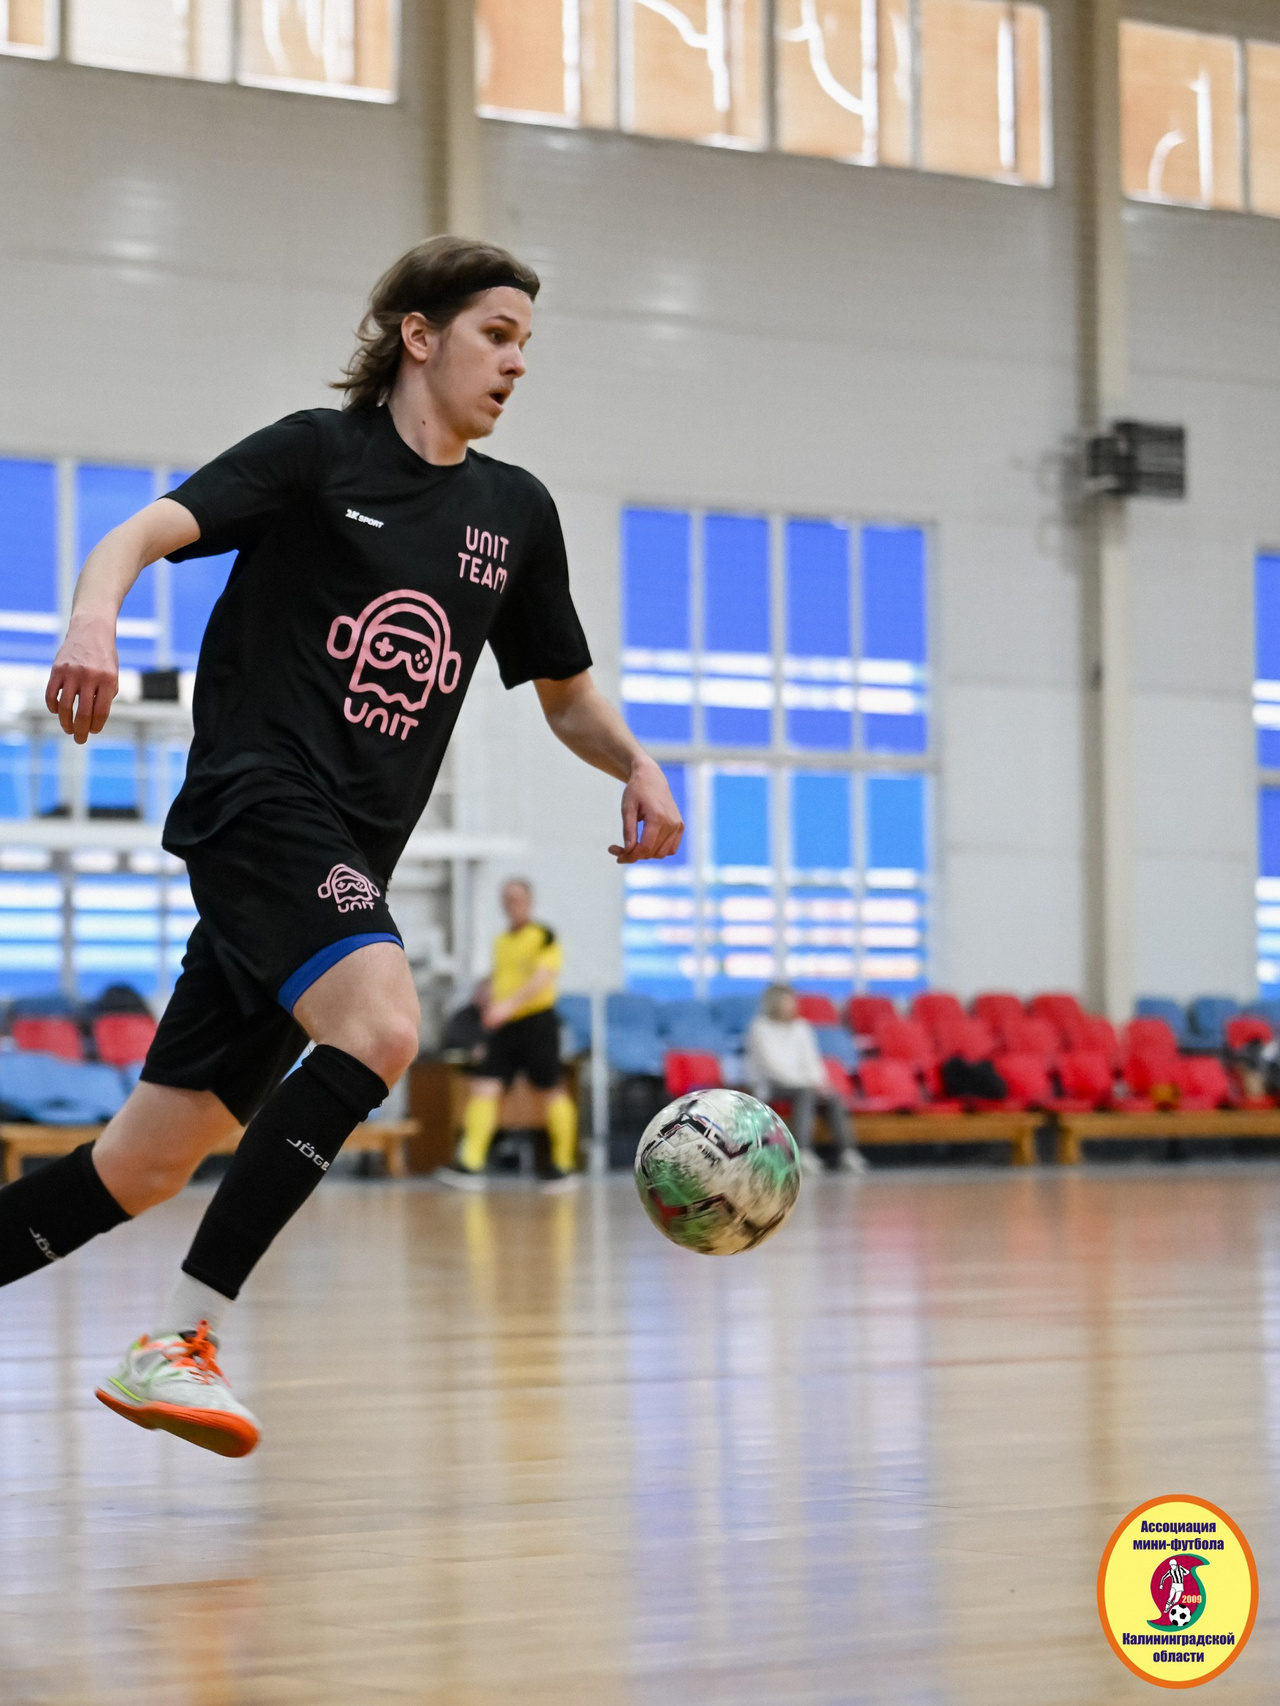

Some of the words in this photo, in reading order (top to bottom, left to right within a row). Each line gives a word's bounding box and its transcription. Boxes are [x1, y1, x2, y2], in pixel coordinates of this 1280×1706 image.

[358, 514, 384, 529] SPORT
[465, 525, 509, 563] UNIT
[457, 552, 508, 594] TEAM
[343, 697, 419, 741] UNIT
[337, 901, 375, 913] UNIT
